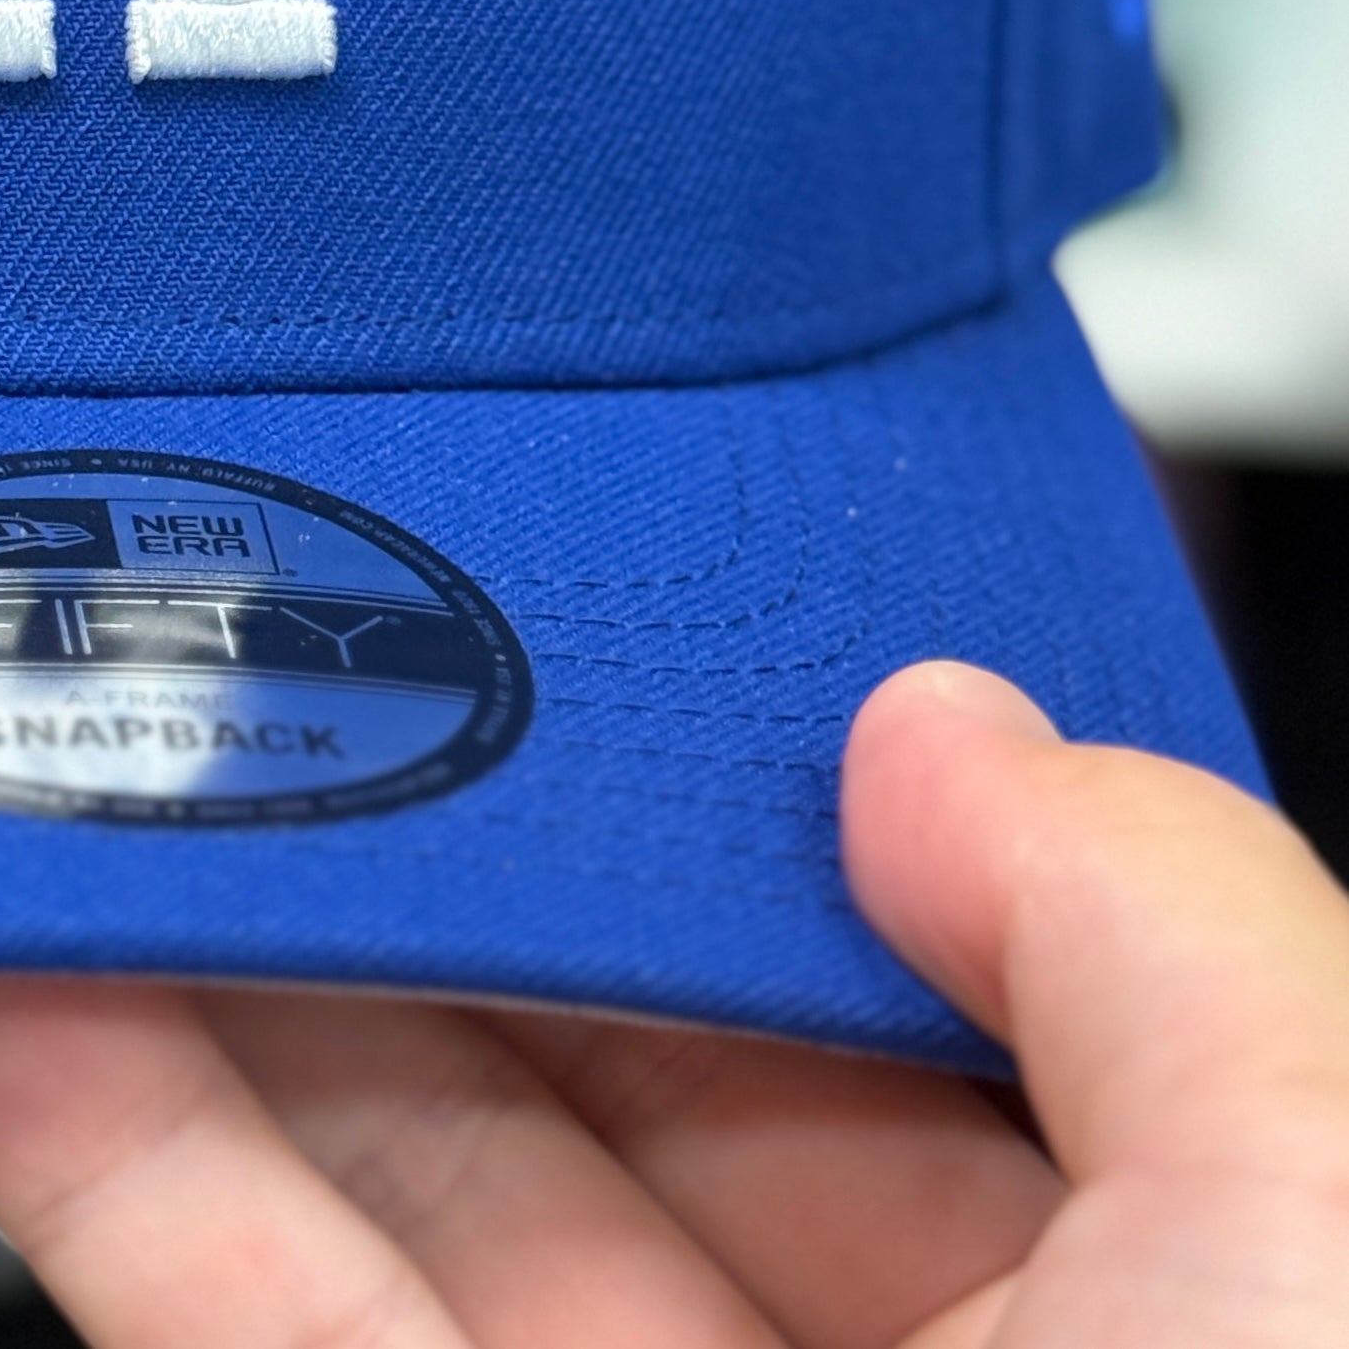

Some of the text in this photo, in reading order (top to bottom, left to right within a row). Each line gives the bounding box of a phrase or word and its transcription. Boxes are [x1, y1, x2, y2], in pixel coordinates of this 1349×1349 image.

[131, 513, 245, 537] NEW
[137, 536, 251, 558] ERA
[64, 688, 236, 711] A-FRAME
